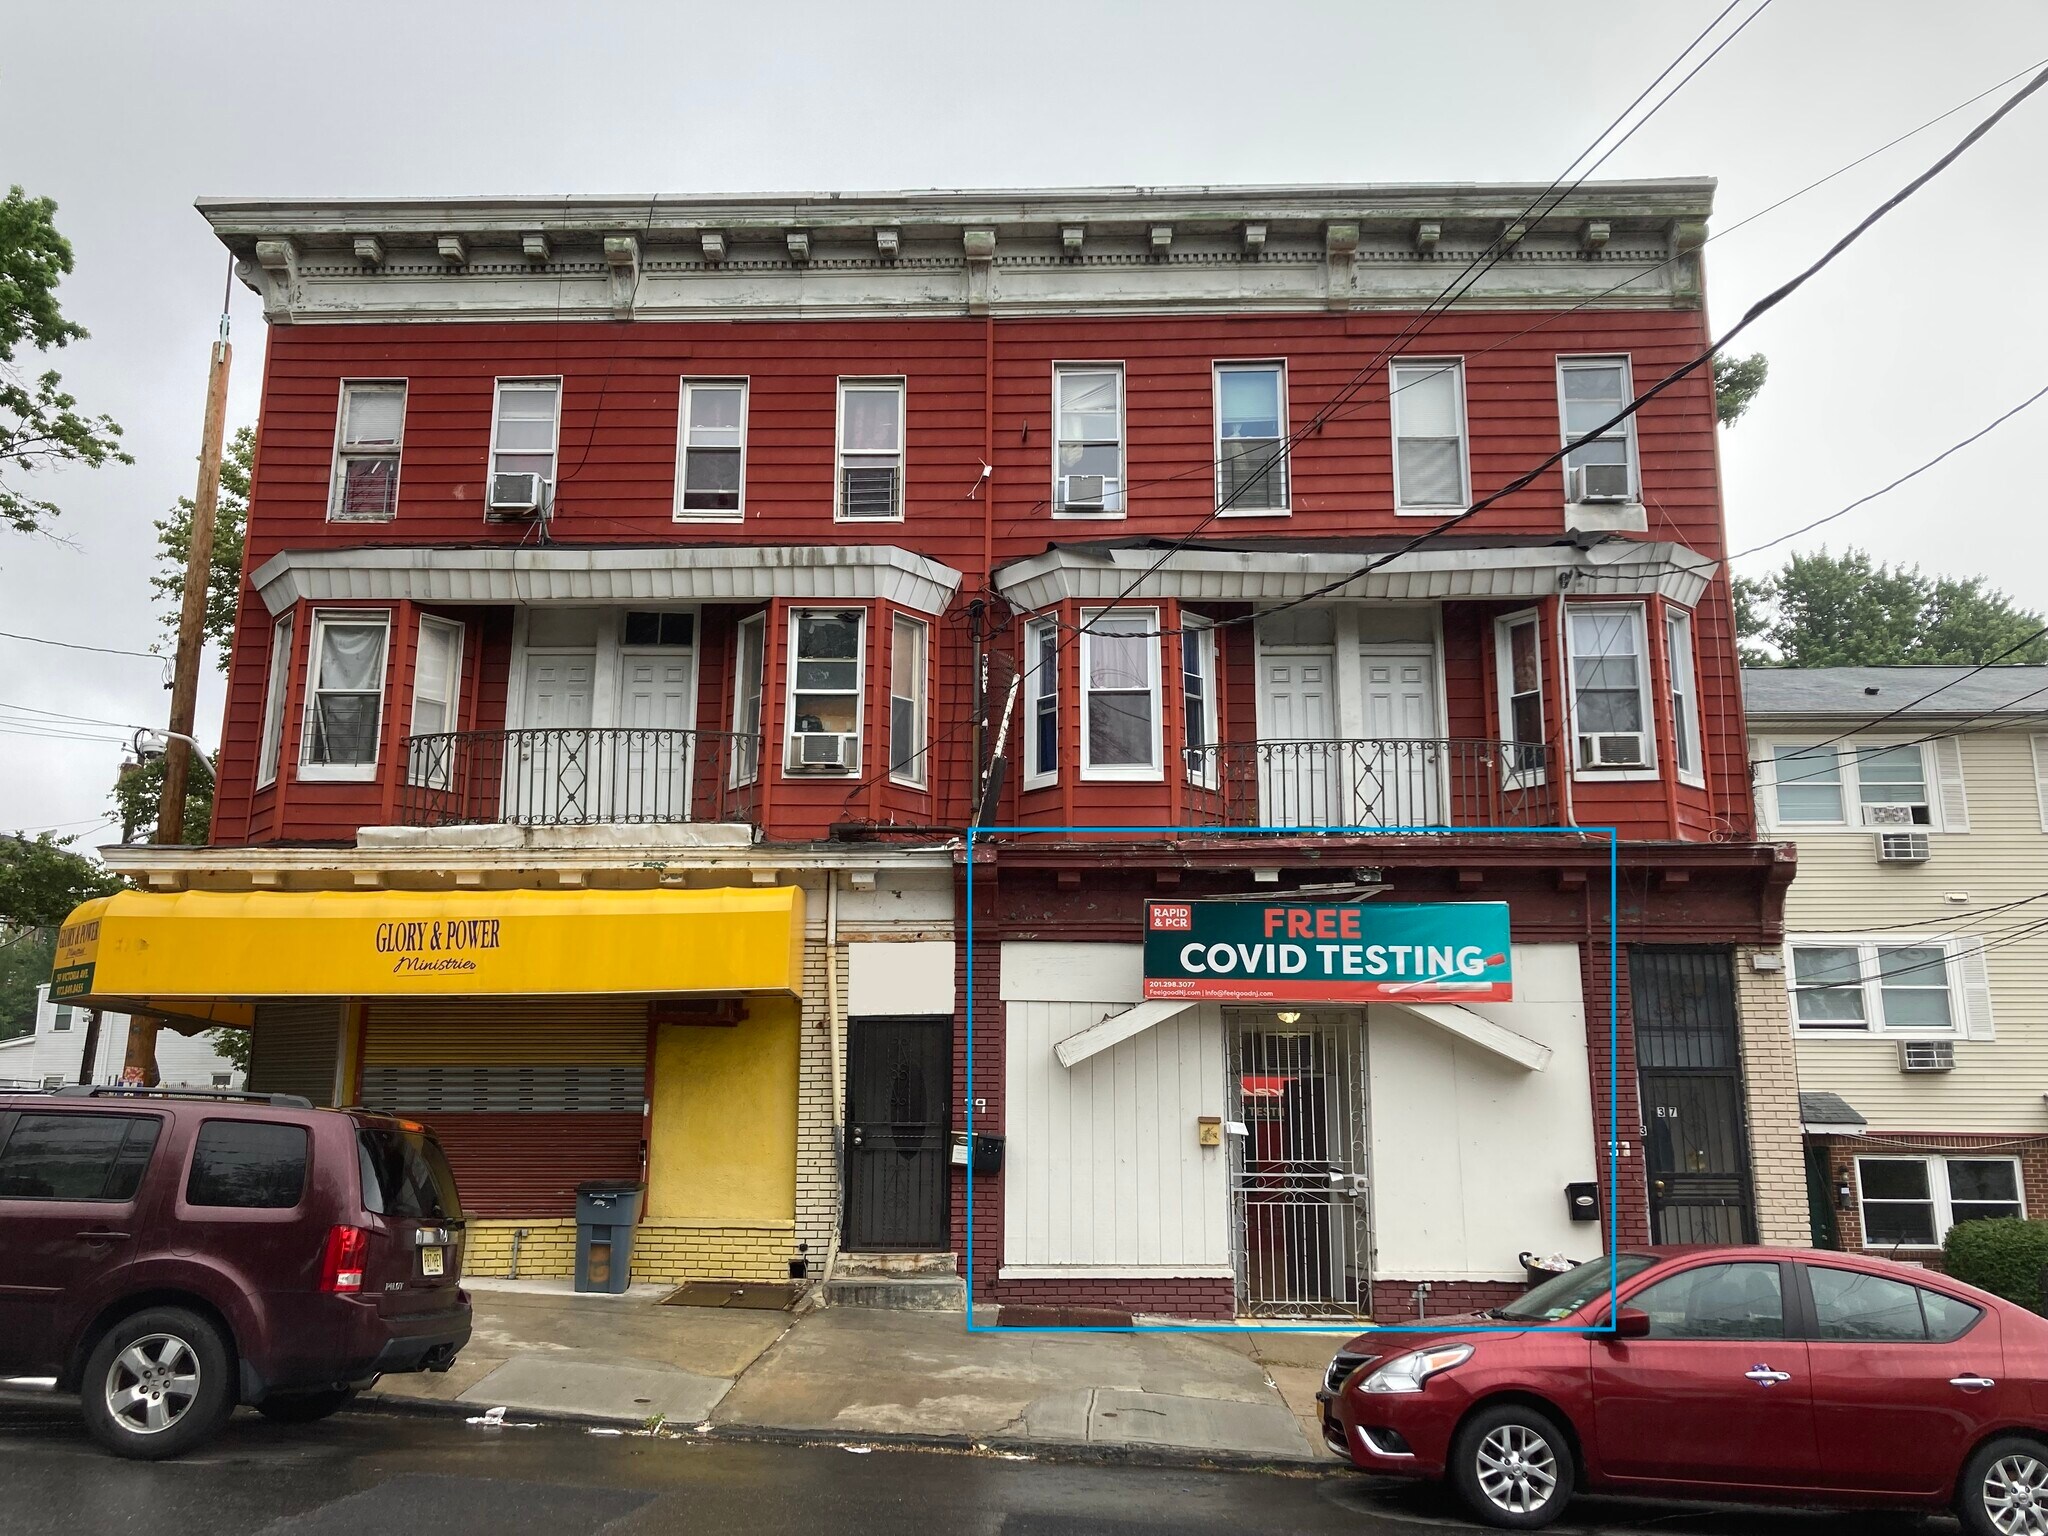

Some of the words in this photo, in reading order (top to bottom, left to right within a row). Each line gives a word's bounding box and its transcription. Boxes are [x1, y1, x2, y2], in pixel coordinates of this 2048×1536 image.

[1154, 908, 1188, 917] RAPID
[1154, 918, 1163, 927] &
[1165, 918, 1188, 927] PCR
[1264, 908, 1361, 938] FREE
[376, 922, 428, 952] GLORY
[430, 921, 442, 951] &
[446, 919, 500, 950] POWER
[393, 956, 476, 973] Ministries
[1180, 943, 1307, 973] COVID
[1316, 944, 1485, 976] TESTING
[385, 1282, 404, 1291] PILOT
